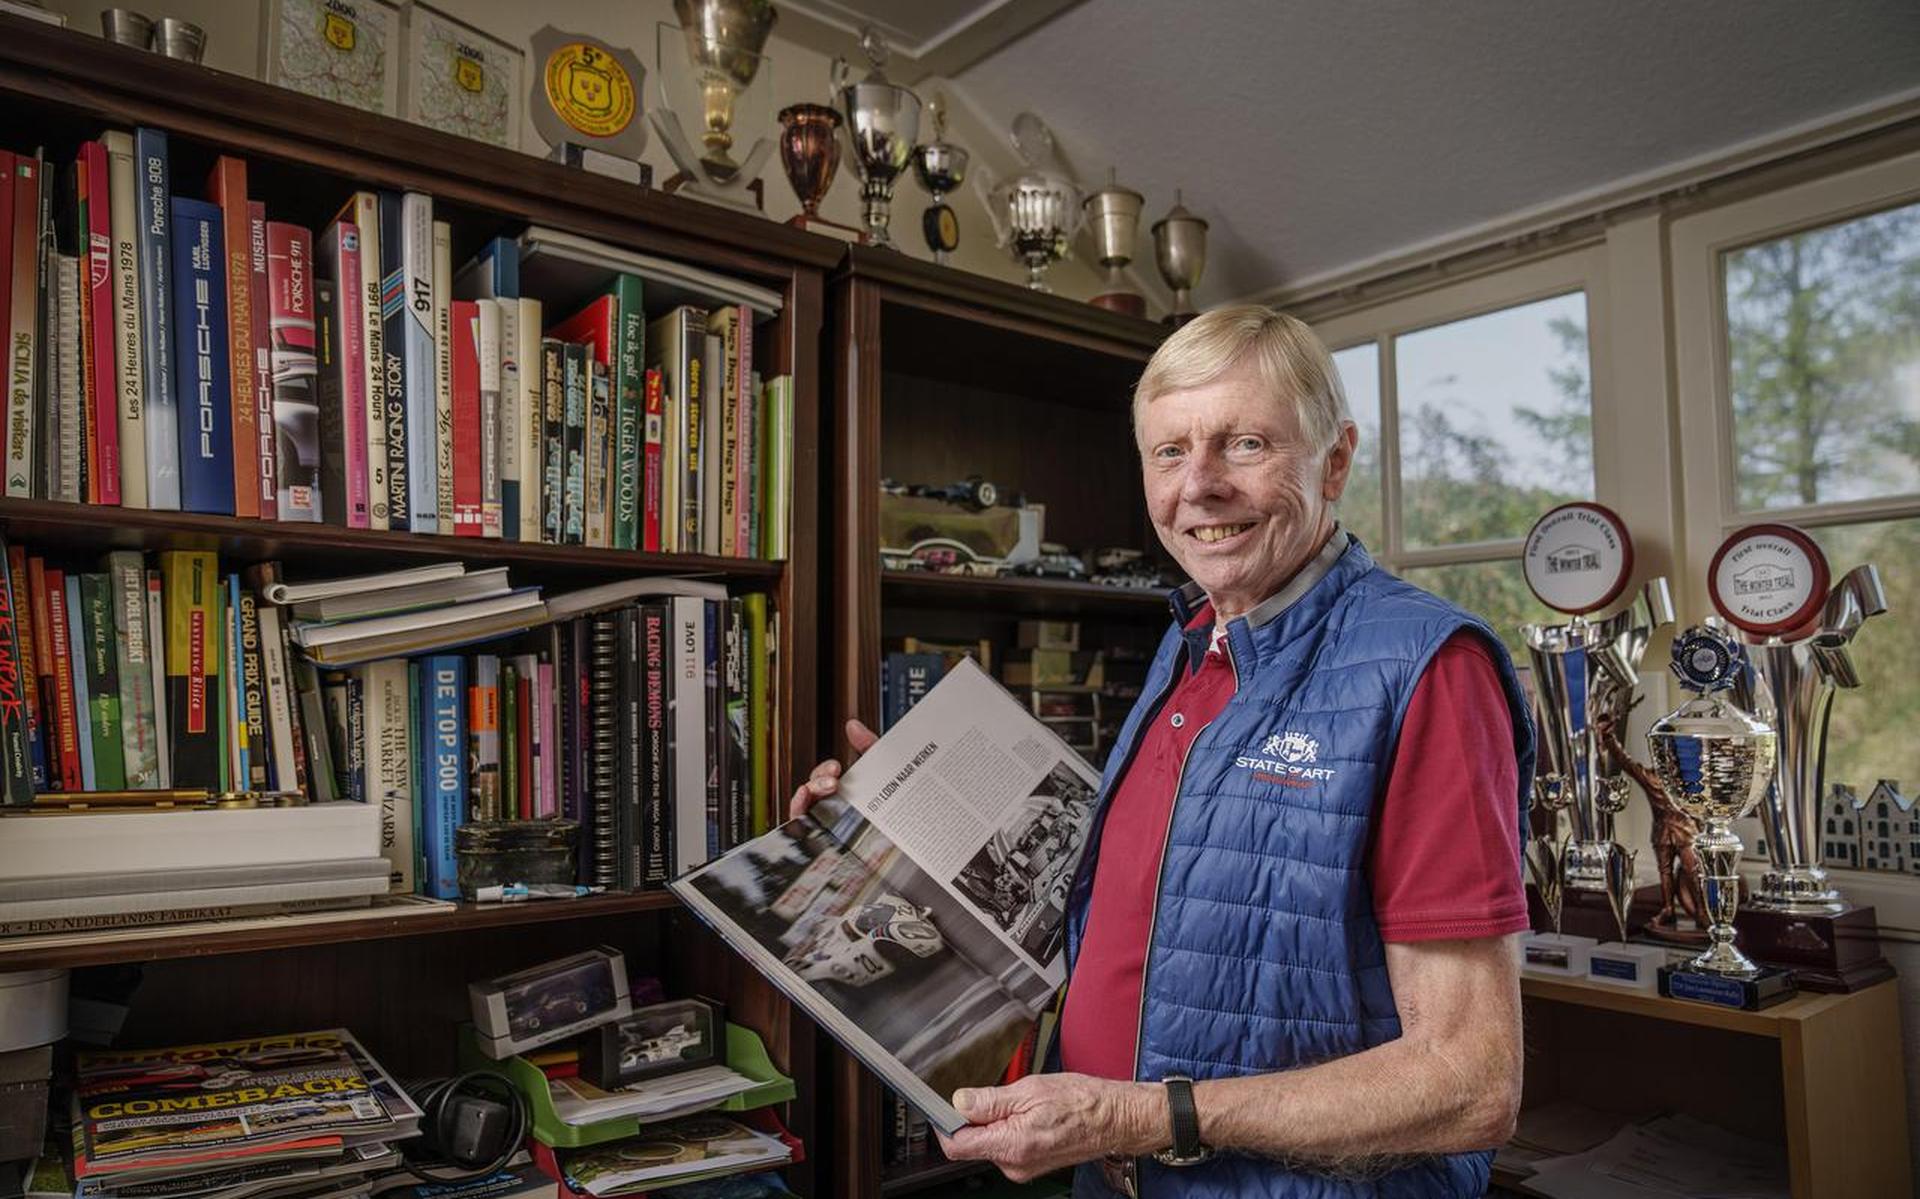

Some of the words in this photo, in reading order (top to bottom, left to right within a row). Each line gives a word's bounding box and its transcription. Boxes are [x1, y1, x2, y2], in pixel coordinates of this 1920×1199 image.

[148, 157, 162, 184] 908
[150, 186, 165, 235] Porsche
[120, 242, 133, 271] 1978
[191, 245, 201, 270] KARL
[200, 220, 211, 271] LUDVIGSEN
[252, 219, 265, 273] MUSEUM
[290, 240, 302, 257] 911
[231, 252, 247, 282] 1978
[123, 275, 135, 309] Mans
[291, 258, 304, 313] PORSCHE
[368, 282, 379, 307] 1991
[414, 278, 429, 312] 917
[124, 313, 136, 329] du
[232, 284, 248, 324] MANS
[369, 311, 380, 325] Le
[234, 327, 249, 350] DU
[626, 313, 639, 339] Hoe
[727, 317, 738, 351] Dogs
[13, 332, 32, 385] SICILIA
[125, 333, 137, 376] Heures
[370, 329, 381, 362] Mans
[626, 341, 637, 353] ik
[195, 278, 214, 458] PORSCHE
[235, 353, 252, 405] HEURES
[371, 366, 381, 381] 24
[388, 353, 402, 397] STORY
[441, 350, 449, 382] HEURES
[623, 354, 638, 380] golf
[727, 357, 737, 391] Dogs
[13, 389, 29, 405] da
[126, 380, 137, 395] 24
[372, 385, 383, 421] Hours
[128, 399, 139, 419] Les
[240, 406, 253, 423] 24
[256, 347, 274, 500] PORSCHE
[727, 398, 737, 432] Dogs
[12, 410, 29, 460] visitare
[390, 402, 404, 458] RACING
[622, 405, 636, 455] TIGER
[486, 395, 495, 500] PORSCHE
[726, 439, 736, 473] Dogs
[391, 463, 406, 518] MARTINI
[440, 475, 452, 520] PORSCHE
[620, 458, 635, 522] WOODS
[725, 480, 735, 515] Dogs
[1577, 512, 1599, 526] Trial
[1732, 544, 1752, 562] First
[1756, 543, 1792, 556] overall
[125, 569, 140, 589] HET
[1748, 577, 1773, 592] WINTER
[1774, 574, 1795, 590] TRIAL
[126, 592, 141, 618] DOEL
[1741, 605, 1764, 617] Trial
[1766, 602, 1794, 617] Class
[240, 597, 256, 649] GRAND
[685, 621, 695, 653] LOVE
[128, 620, 144, 664] BEREIKT
[192, 612, 201, 673] MASTERING
[647, 616, 663, 667] RACING
[244, 653, 258, 687] PRIX
[437, 670, 456, 699] DE
[685, 658, 695, 679] 911
[192, 676, 203, 709] Risico
[647, 671, 663, 729] DEMONS
[247, 691, 262, 736] GUIDE
[439, 705, 457, 747] TOP
[381, 727, 394, 785] MARKET
[394, 727, 406, 753] THE
[396, 759, 407, 790] NEW
[439, 754, 458, 791] 500
[652, 765, 660, 781] AND
[879, 780, 900, 801] LOON
[897, 763, 916, 784] NAAR
[911, 740, 939, 768] WERKEN
[1235, 757, 1287, 774] STATE
[1301, 769, 1336, 780] ART
[383, 791, 400, 848] WIZARDS
[28, 919, 57, 933] EEN
[62, 910, 158, 931] NEDERLANDS
[161, 906, 233, 922] FABRIKAAT
[89, 1075, 370, 1119] COMEBACK
